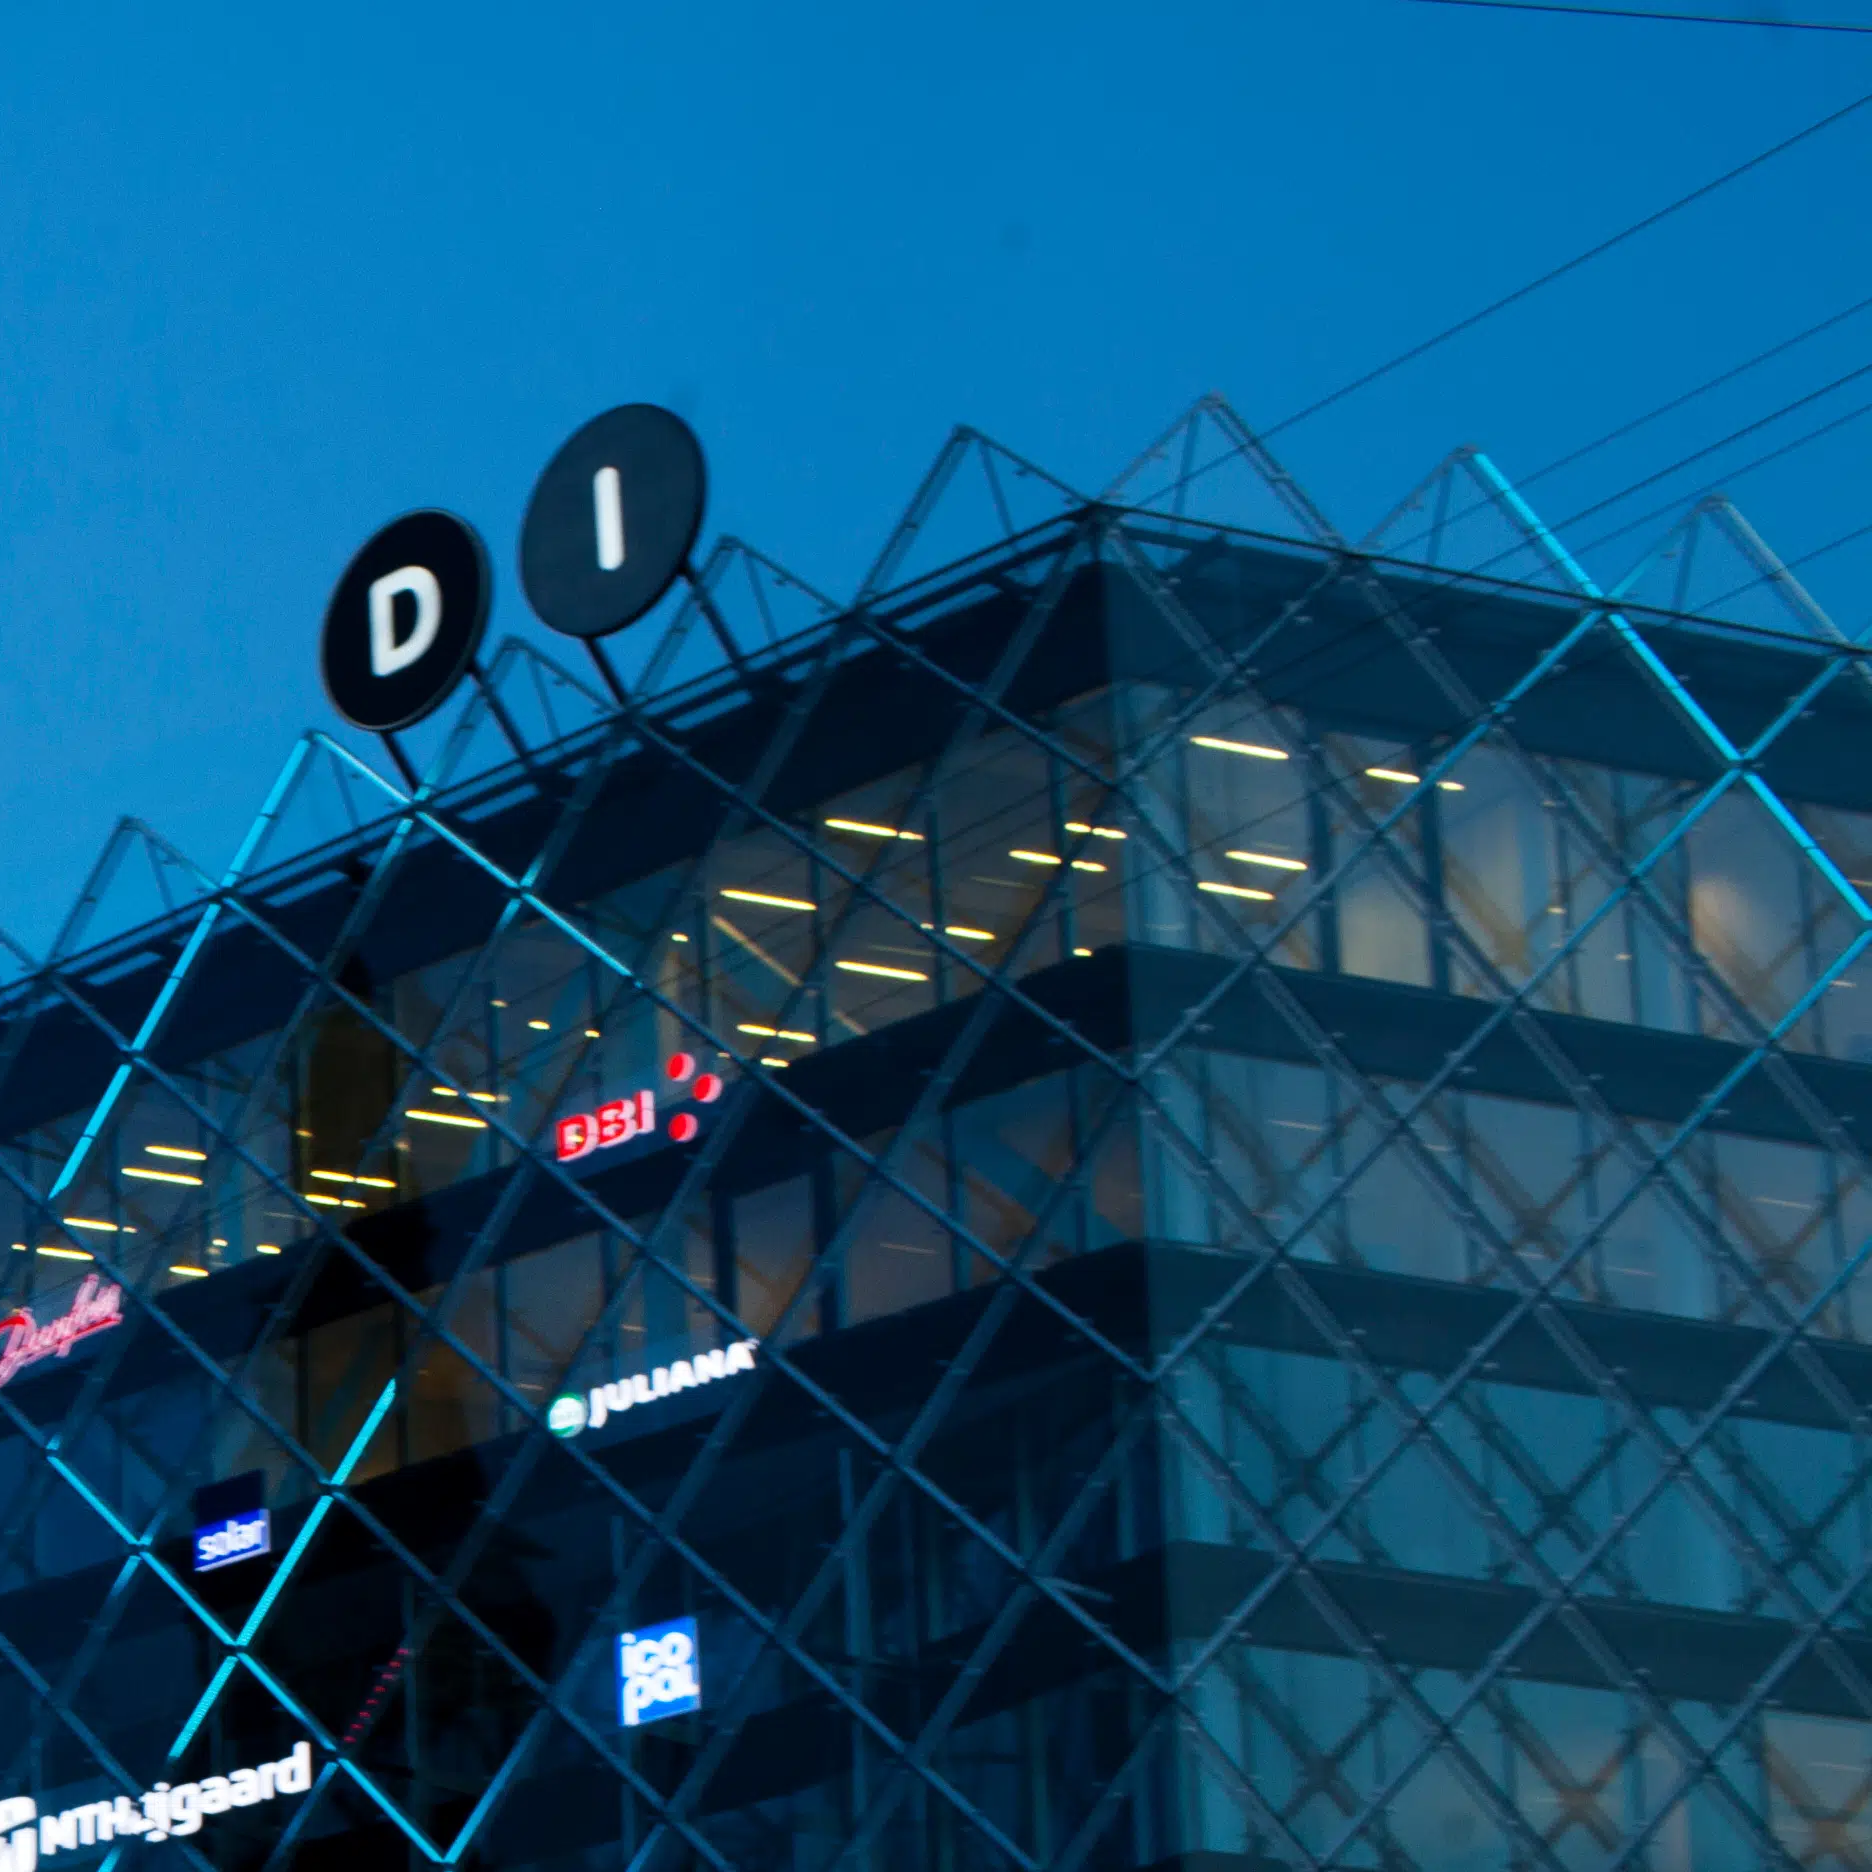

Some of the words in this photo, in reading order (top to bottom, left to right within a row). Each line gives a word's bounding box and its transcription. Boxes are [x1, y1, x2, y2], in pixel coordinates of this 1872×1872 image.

[369, 565, 443, 676] D
[593, 466, 626, 571] I
[556, 1090, 655, 1162] DBI
[588, 1341, 756, 1428] JULIANA
[198, 1520, 266, 1560] solar
